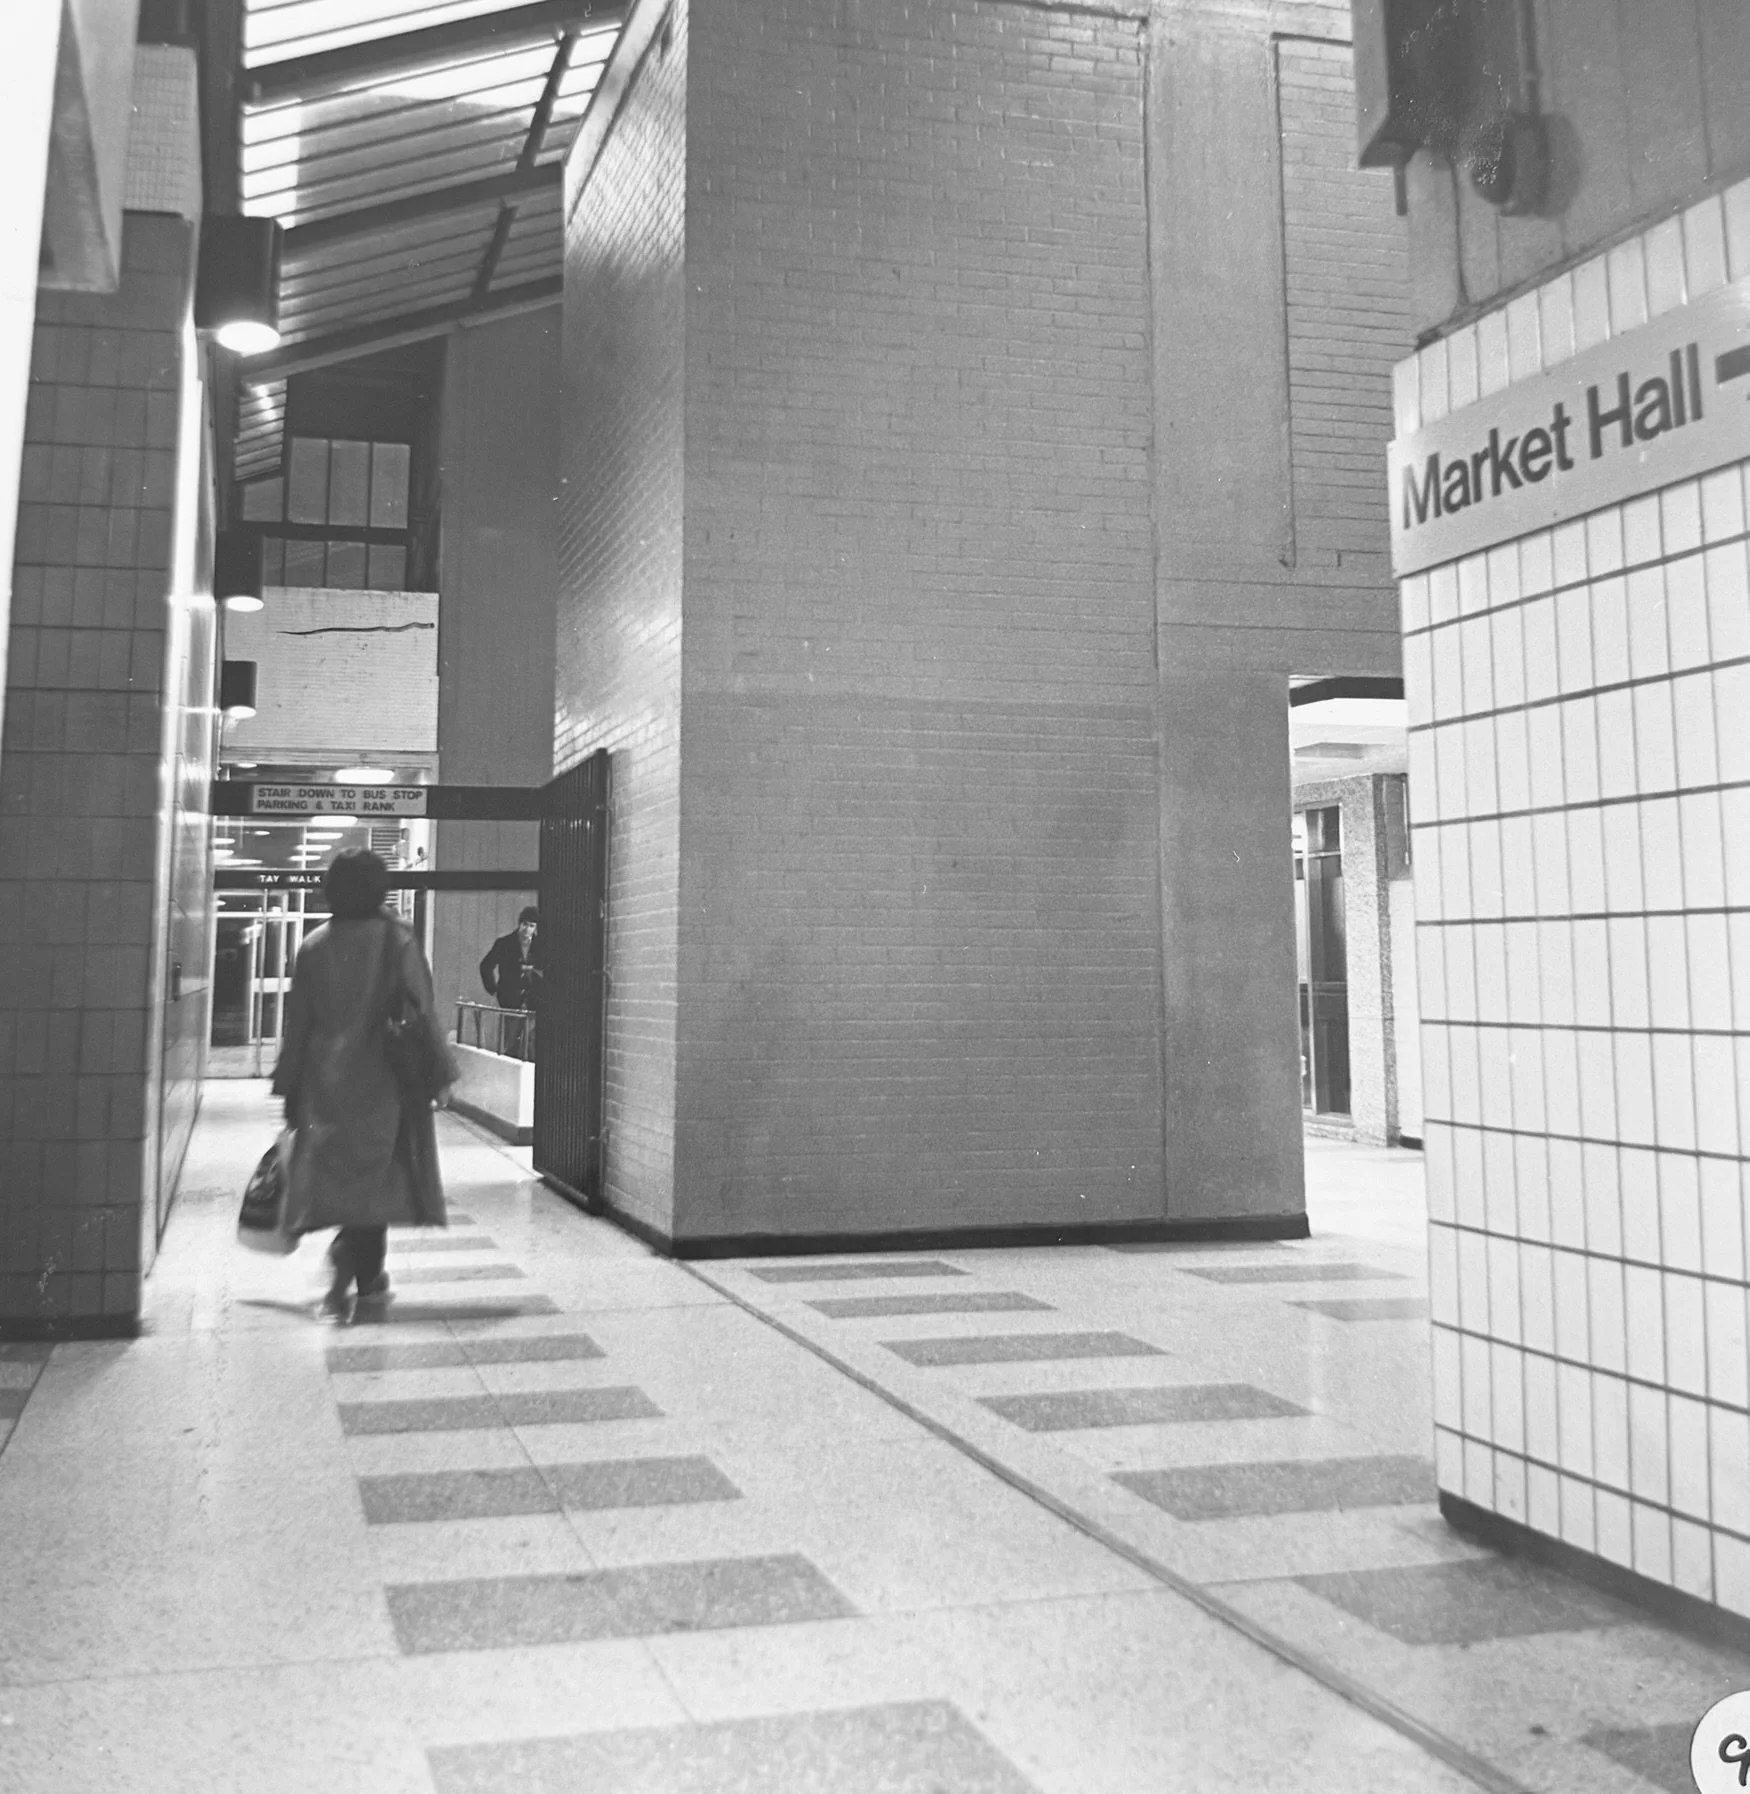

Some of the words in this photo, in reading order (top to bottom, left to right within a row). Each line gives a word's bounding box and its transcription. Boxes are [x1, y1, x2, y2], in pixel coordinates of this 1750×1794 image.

[1401, 402, 1575, 530] Market
[1586, 342, 1704, 460] Hall
[257, 788, 291, 799] STAIR
[299, 788, 336, 799] DOWN
[341, 789, 356, 799] TO
[363, 789, 386, 800] BUS
[393, 789, 424, 801] STOP
[256, 800, 308, 811] PARKING
[315, 801, 324, 811] &
[331, 801, 356, 811] TAXI
[363, 801, 396, 812] RANK
[259, 874, 280, 884] TAY
[289, 875, 322, 884] WALK
